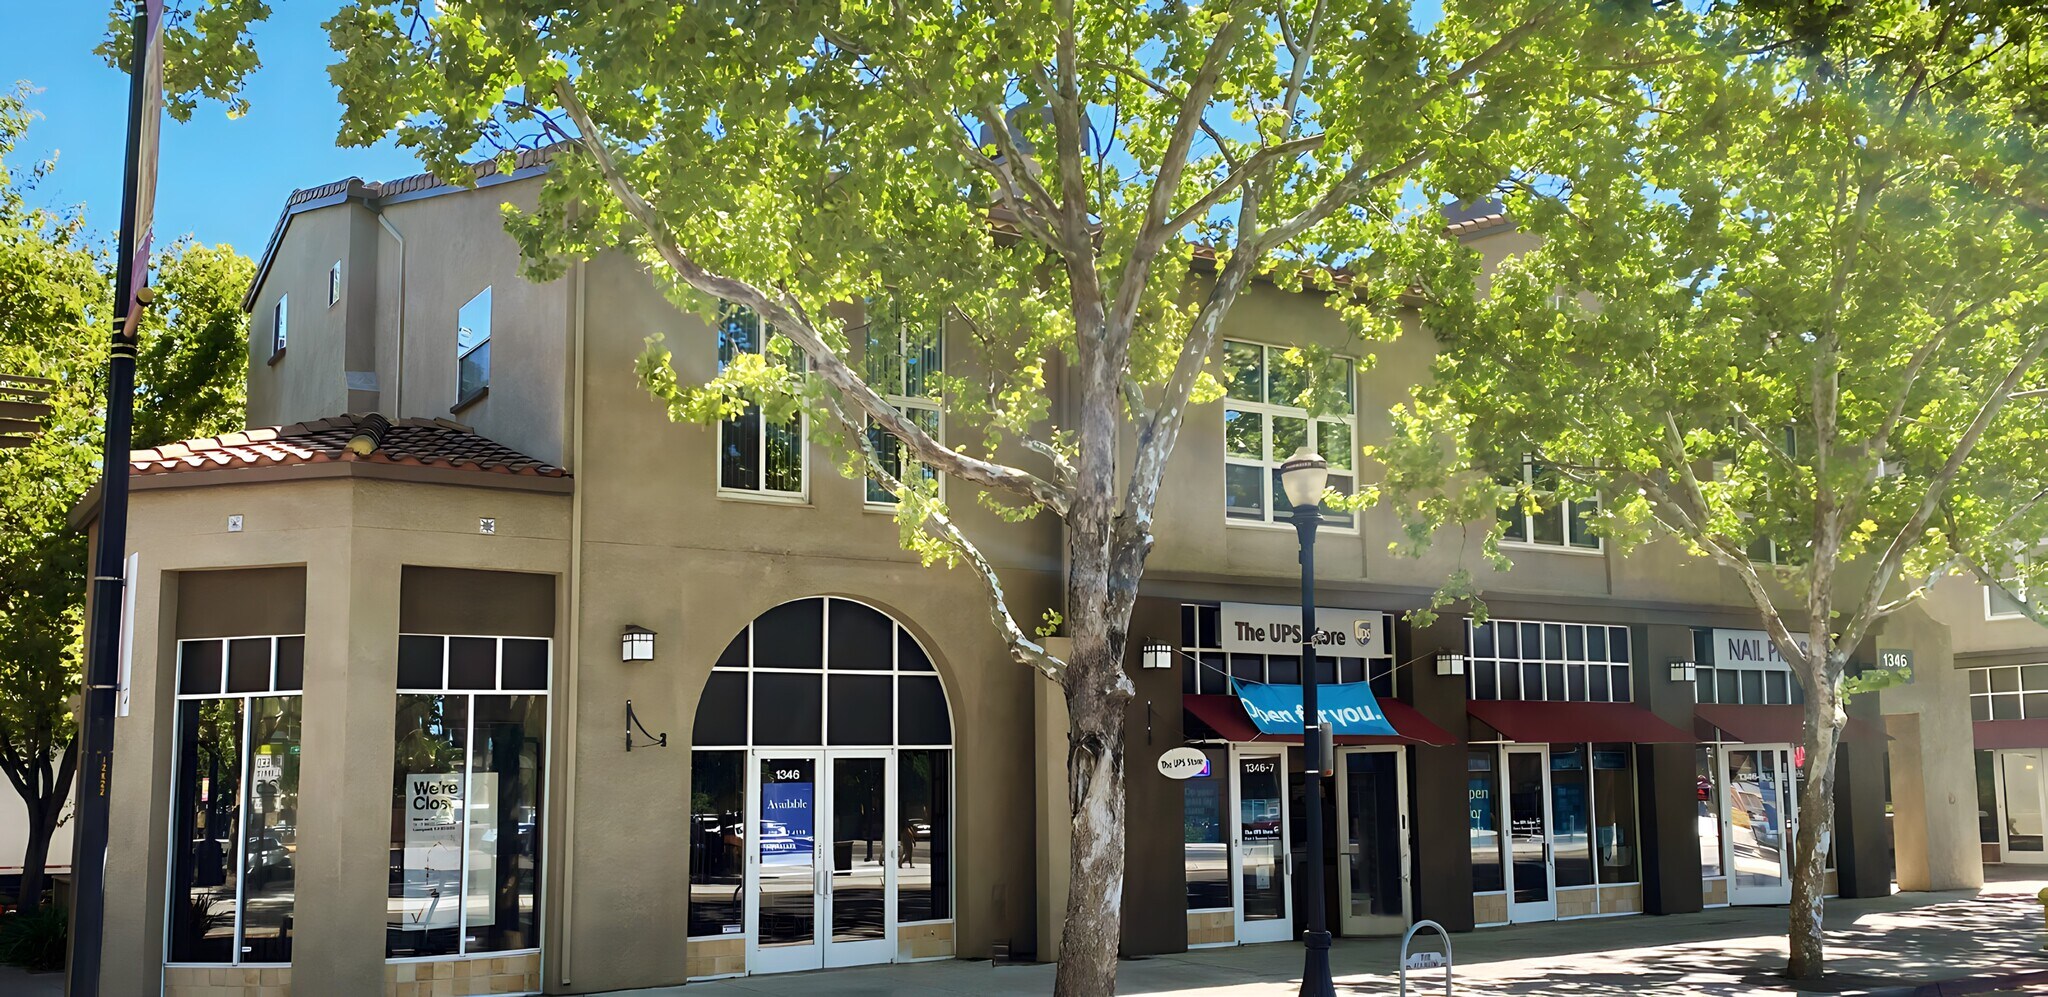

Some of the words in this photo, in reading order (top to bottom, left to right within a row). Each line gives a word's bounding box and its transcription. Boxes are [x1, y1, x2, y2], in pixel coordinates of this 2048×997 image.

[1235, 621, 1265, 642] The
[1269, 623, 1302, 643] UPS
[1728, 638, 1765, 661] NAIL
[1883, 653, 1909, 668] 1346
[1294, 704, 1328, 723] fr
[1328, 704, 1382, 728] you.
[775, 769, 801, 780] 1346
[1245, 763, 1275, 773] 1346-7
[413, 781, 458, 796] We're
[1469, 789, 1489, 803] pen
[767, 798, 808, 810] Available
